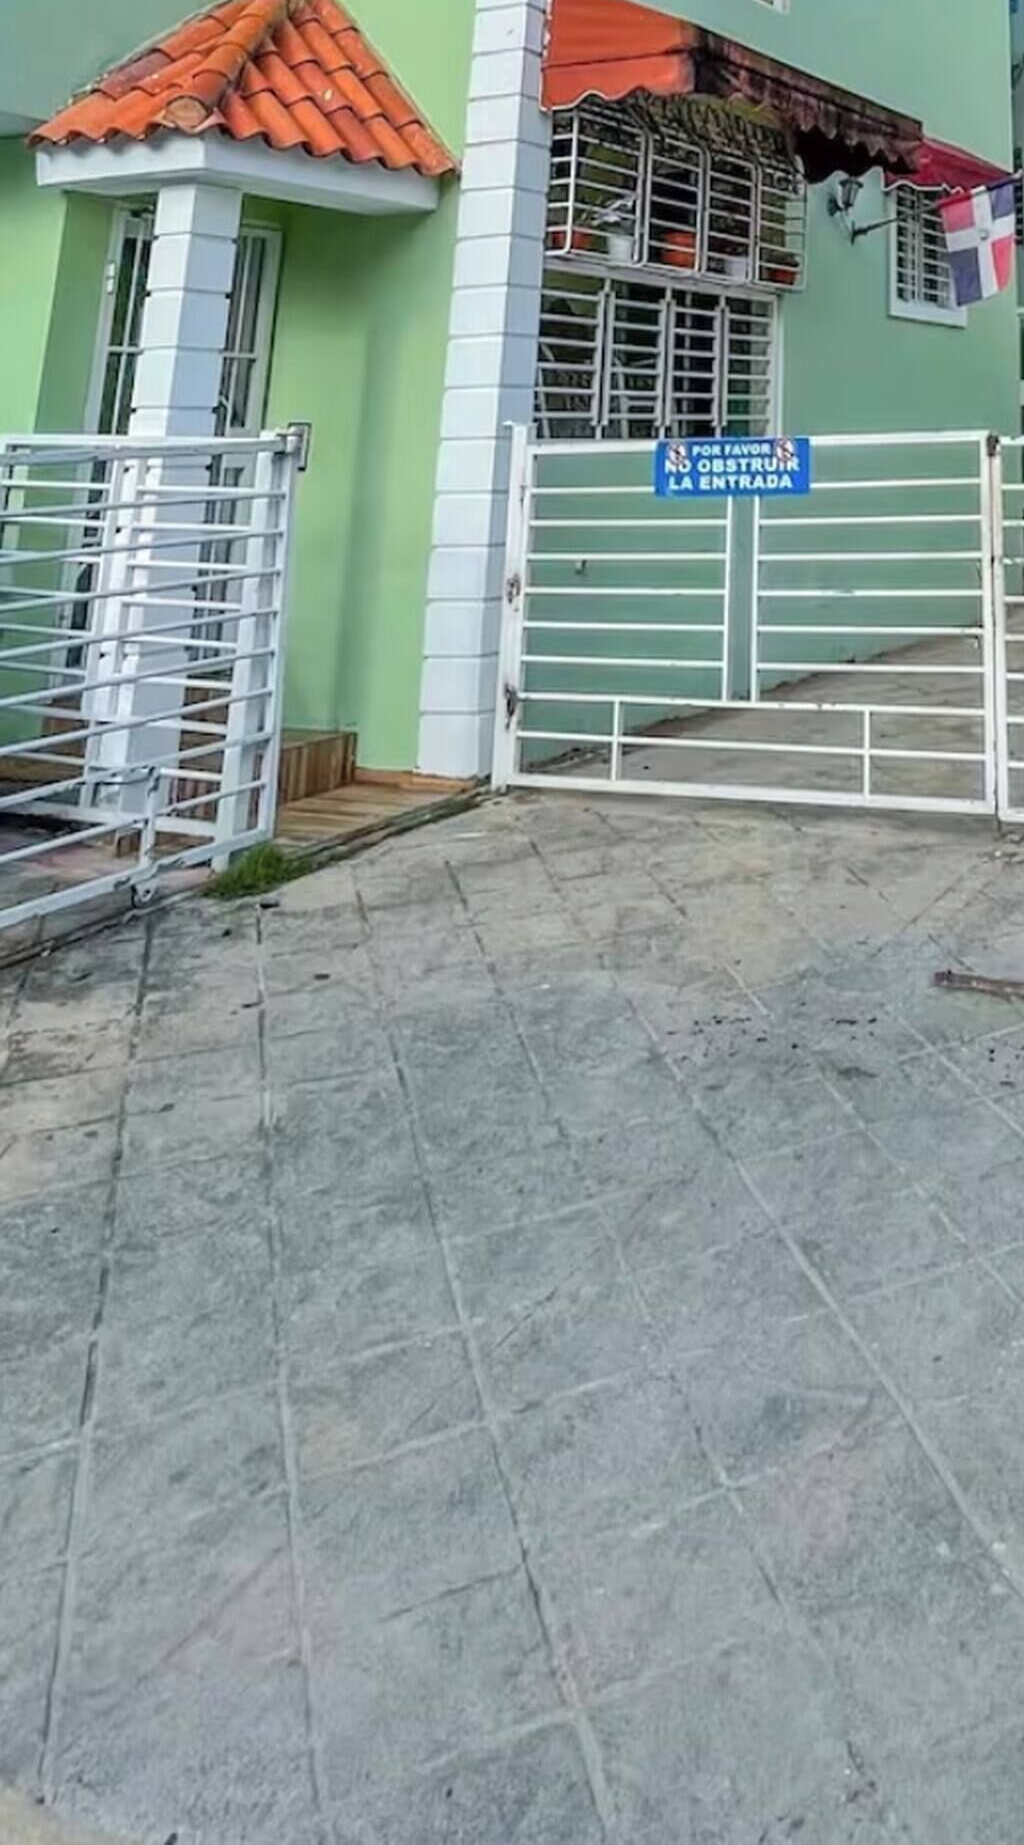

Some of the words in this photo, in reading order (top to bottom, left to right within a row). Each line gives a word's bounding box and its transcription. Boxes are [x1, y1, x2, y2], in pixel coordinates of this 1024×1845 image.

[692, 444, 720, 456] POR
[724, 443, 771, 455] FAVOR
[664, 457, 691, 473] NO
[697, 456, 800, 473] OBSTRUIR
[669, 476, 693, 490] LA
[699, 474, 793, 490] ENTRADA
